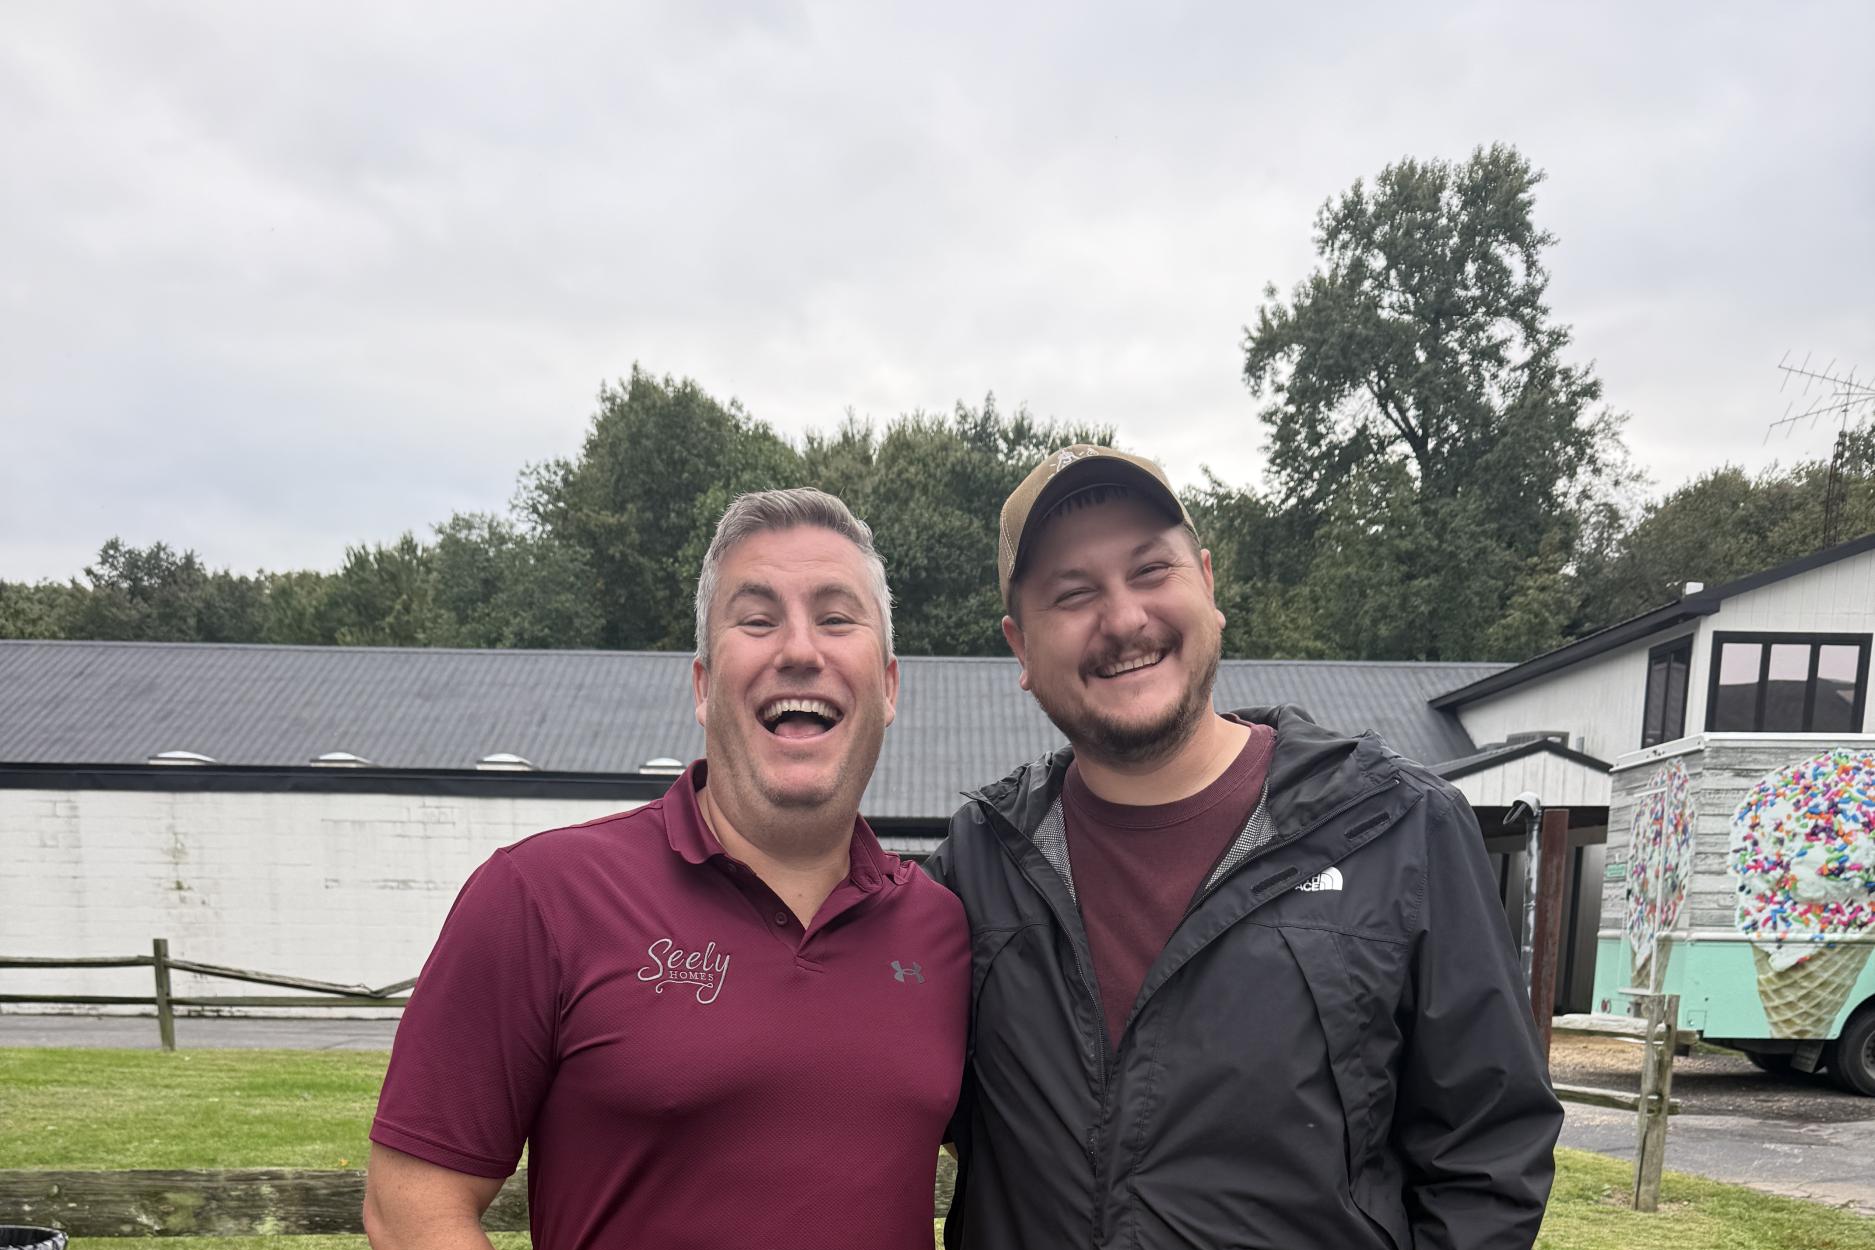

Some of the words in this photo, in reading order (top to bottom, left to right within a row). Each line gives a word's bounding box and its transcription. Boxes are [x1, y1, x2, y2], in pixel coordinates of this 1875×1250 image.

[1295, 882, 1320, 891] ACE
[637, 938, 730, 1004] Seely
[669, 970, 714, 982] HOMES
